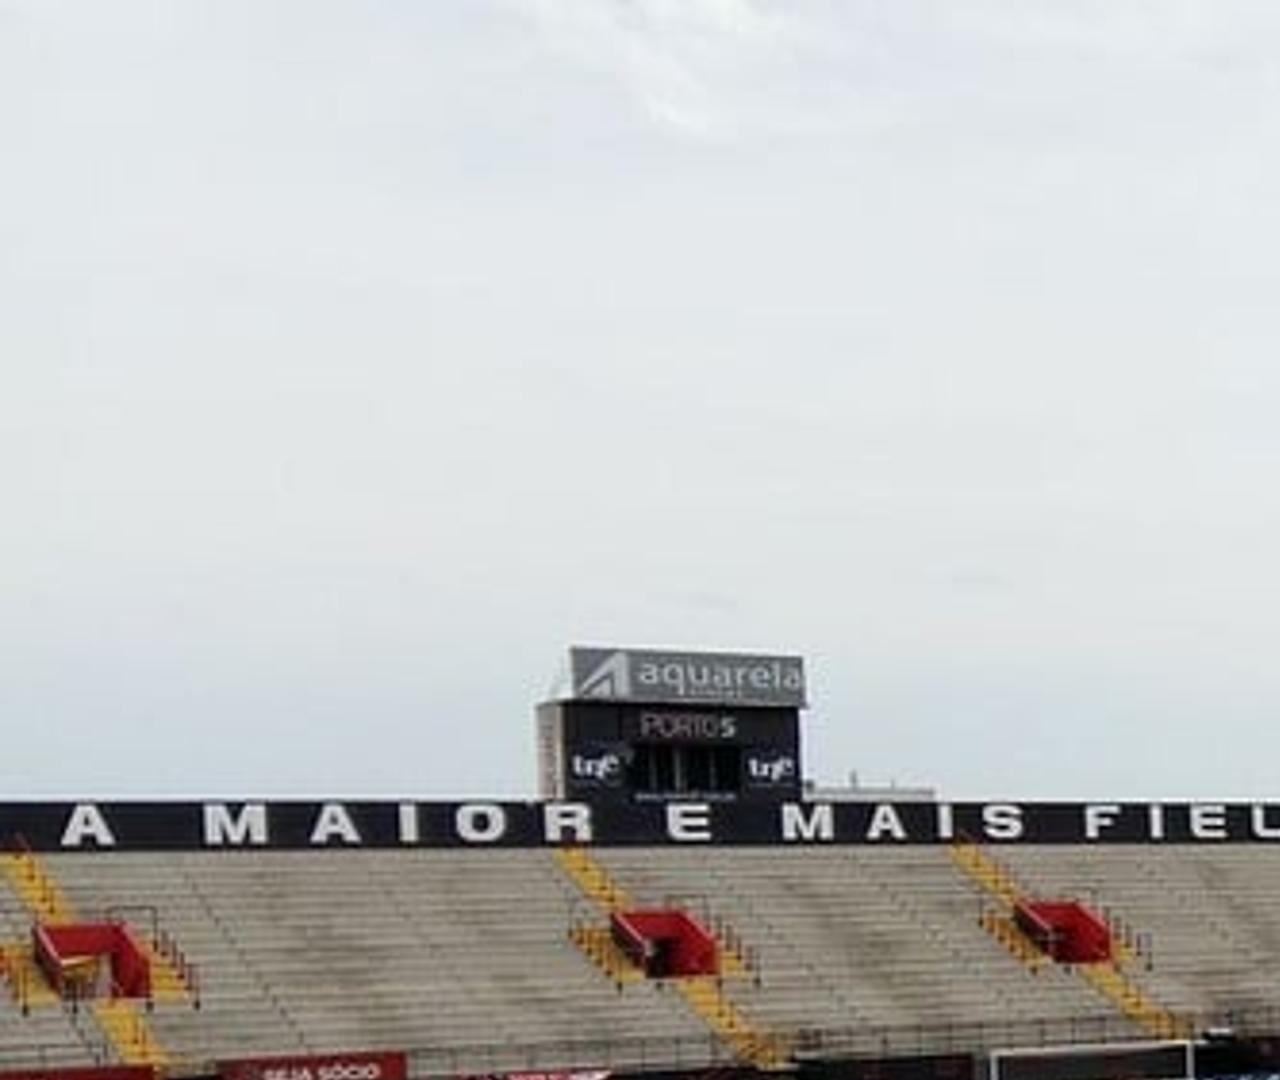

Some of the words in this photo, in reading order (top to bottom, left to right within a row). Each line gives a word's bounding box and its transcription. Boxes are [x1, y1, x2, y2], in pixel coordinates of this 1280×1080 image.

[640, 661, 801, 697] aquarela
[60, 804, 115, 846] A
[203, 803, 593, 844] MAIOR
[667, 804, 711, 841] E
[782, 804, 1024, 840] MAIS
